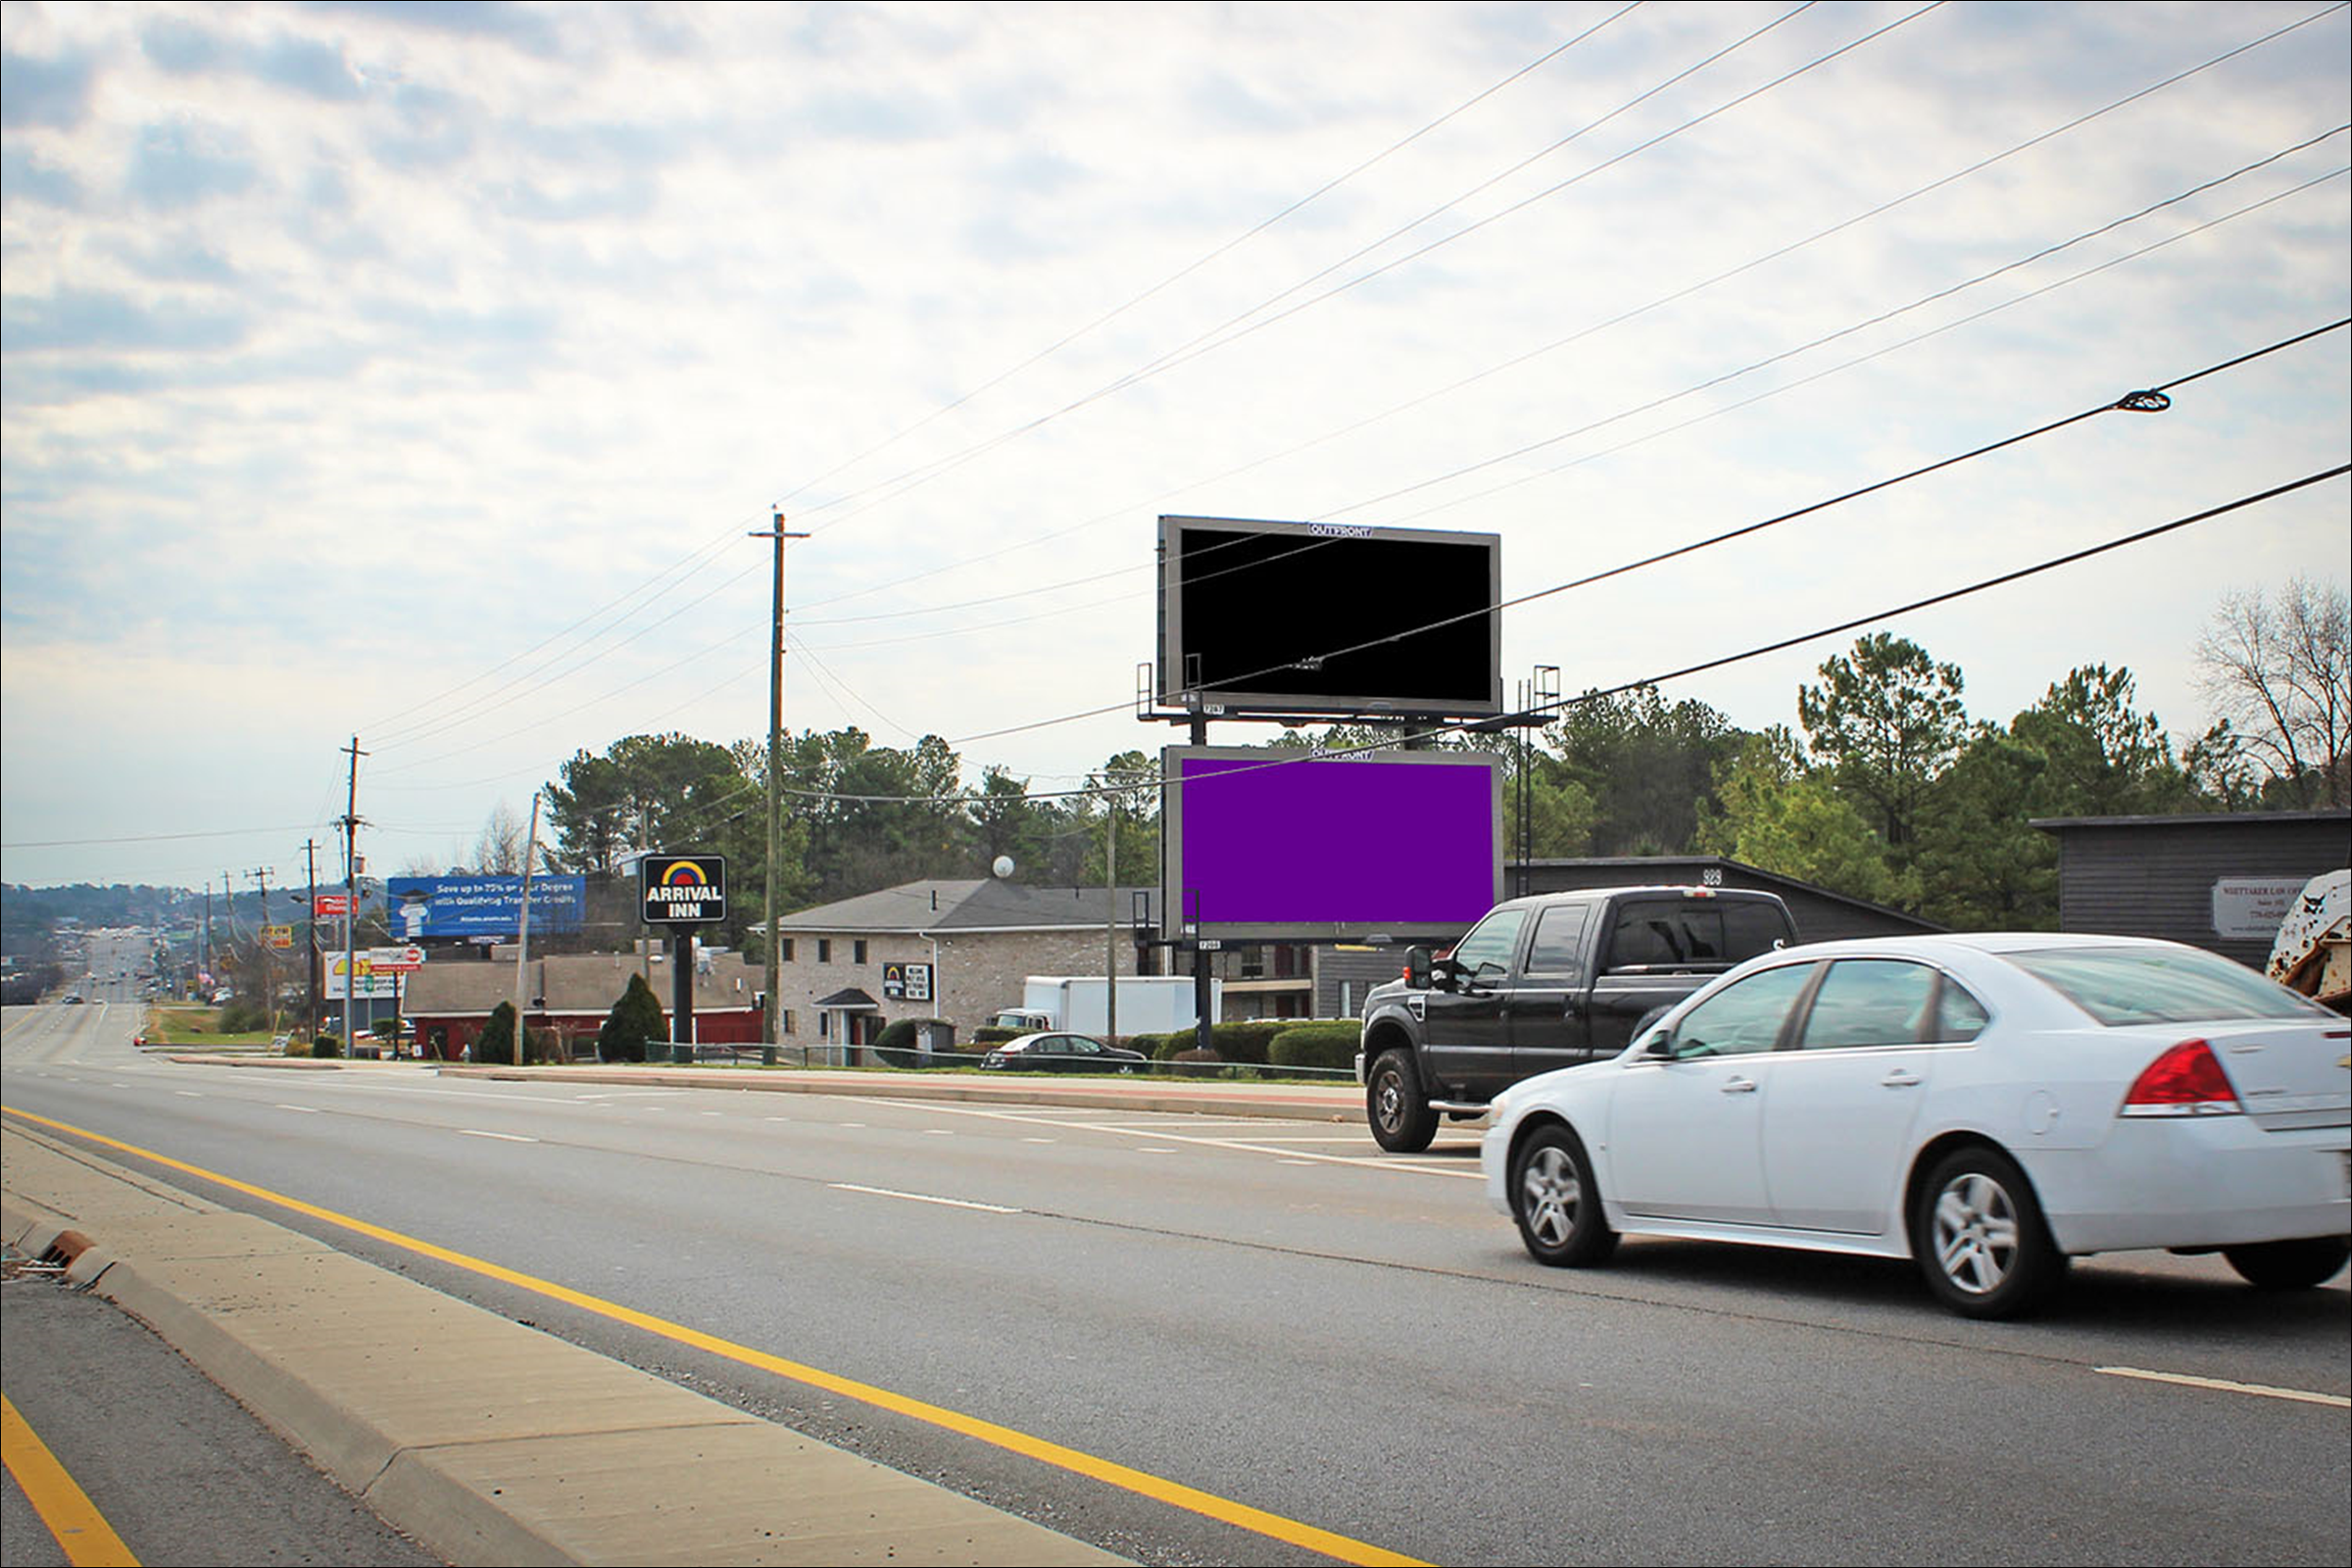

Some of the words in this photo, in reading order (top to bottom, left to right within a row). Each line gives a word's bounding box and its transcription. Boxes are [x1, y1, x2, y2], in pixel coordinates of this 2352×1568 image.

[1311, 523, 1372, 538] OUTFRONT
[1703, 868, 1722, 886] 929
[436, 884, 459, 893] Save
[461, 886, 472, 895] up
[473, 884, 483, 893] to
[541, 883, 574, 894] Degree
[647, 886, 722, 902] ARRIVAL
[2223, 886, 2269, 896] WHITTAKER
[456, 897, 502, 906] Qualifying
[668, 903, 702, 917] INN
